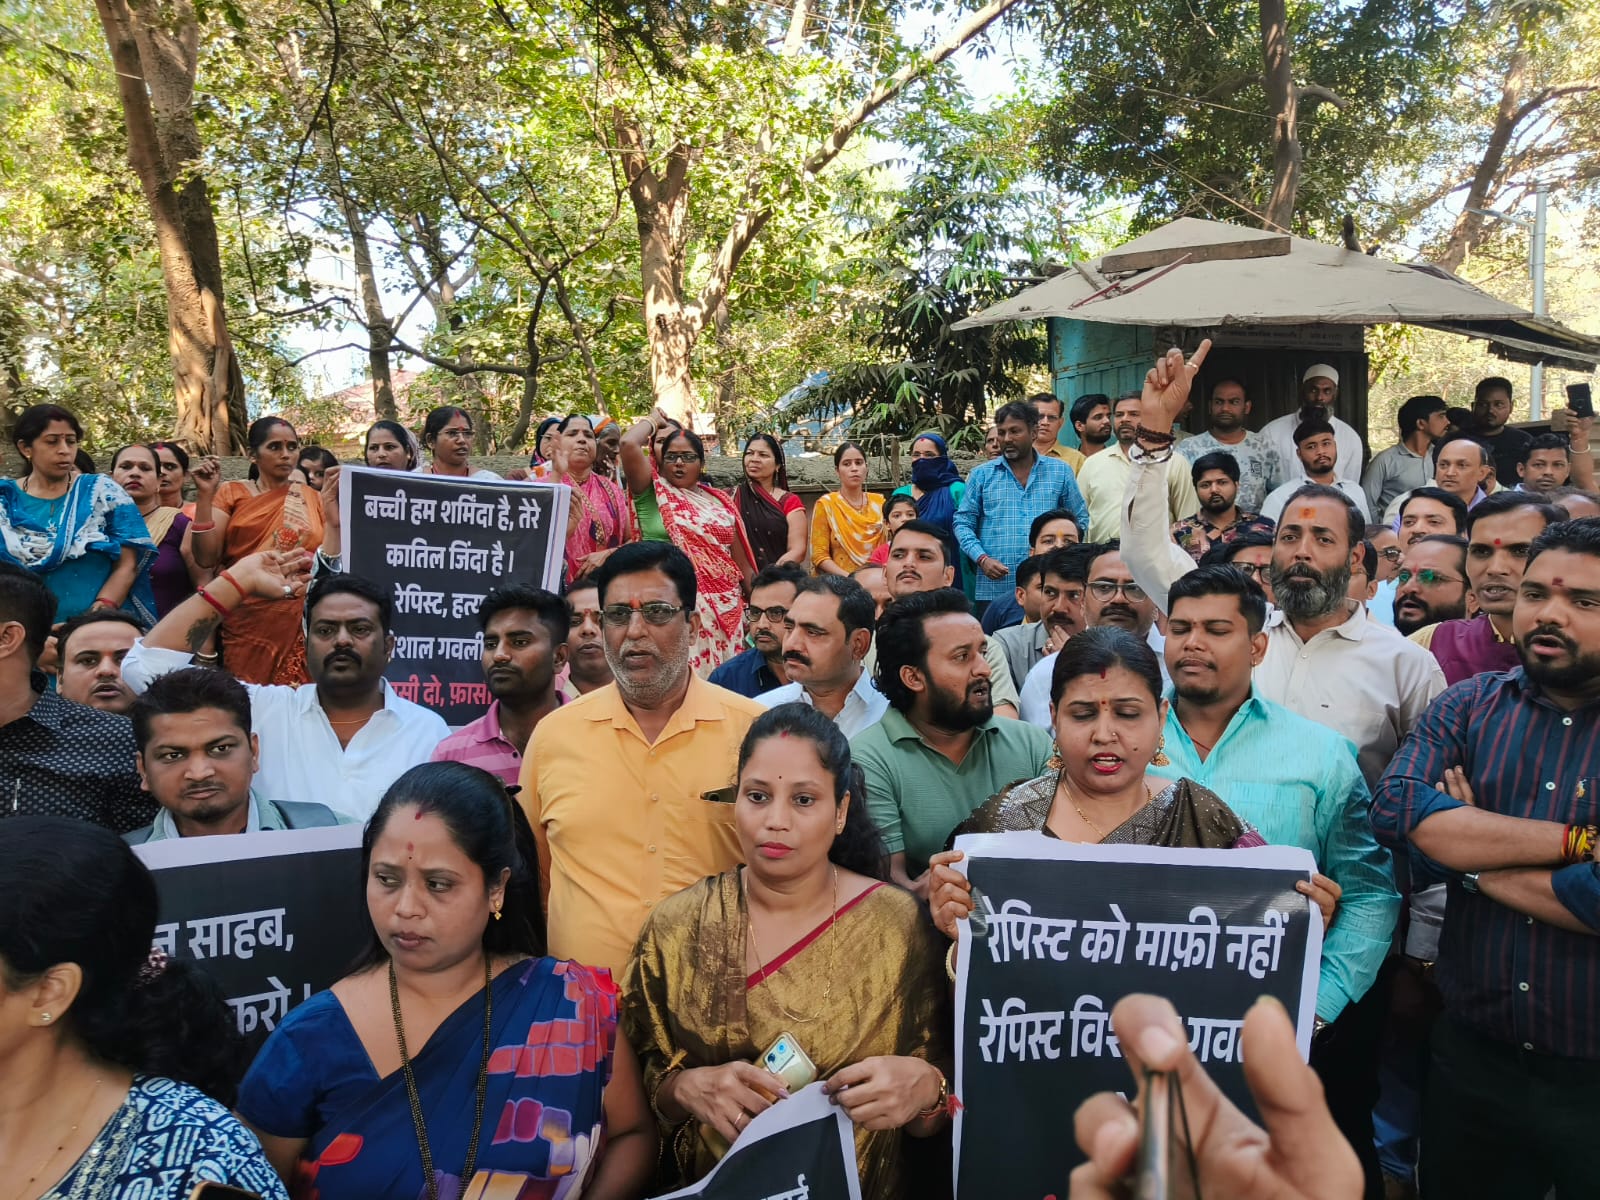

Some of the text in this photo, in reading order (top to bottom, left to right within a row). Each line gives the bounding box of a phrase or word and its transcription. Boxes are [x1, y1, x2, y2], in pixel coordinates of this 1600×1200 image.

[364, 489, 407, 520] बच्ची
[410, 498, 437, 525] हम
[518, 498, 541, 529] तेरे
[386, 537, 446, 570] कातिल
[449, 540, 488, 574] जिंदा
[395, 583, 447, 618] रेपिस्ट,
[186, 908, 294, 959] साहब,
[981, 895, 1290, 978] रेपिस्ट को माफ़ी नहीं
[978, 997, 1065, 1063] रेपिस्ट
